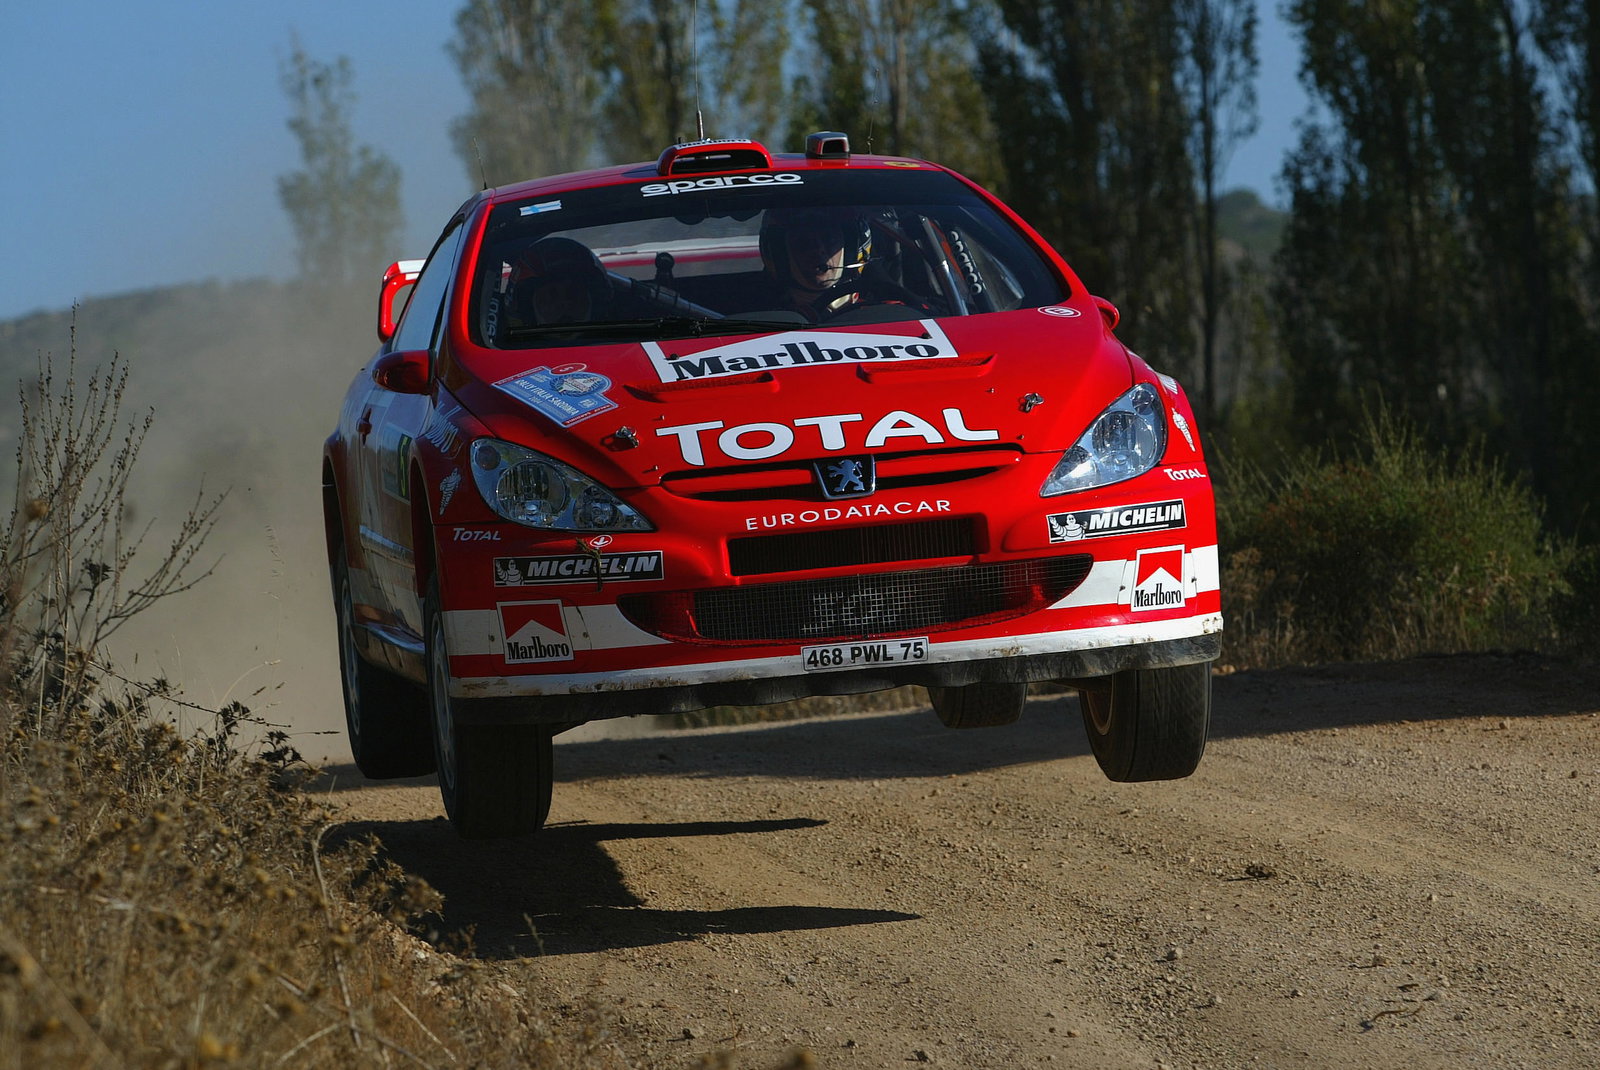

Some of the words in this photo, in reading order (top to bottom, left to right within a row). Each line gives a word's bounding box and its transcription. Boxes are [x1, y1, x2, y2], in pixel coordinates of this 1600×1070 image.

[640, 173, 803, 197] sparco
[669, 341, 940, 381] Marlboro
[656, 407, 999, 467] TOTAL
[1163, 467, 1206, 482] TOTAL
[745, 499, 952, 531] EURODATACAR
[1088, 502, 1183, 531] MICHELIN
[452, 527, 502, 542] TOTAL
[527, 555, 658, 577] MICHELIN
[1133, 582, 1183, 608] Marlboro
[506, 635, 571, 661] Marlboro
[807, 647, 843, 668] 468
[850, 644, 894, 664] PWL
[900, 641, 924, 661] 75
